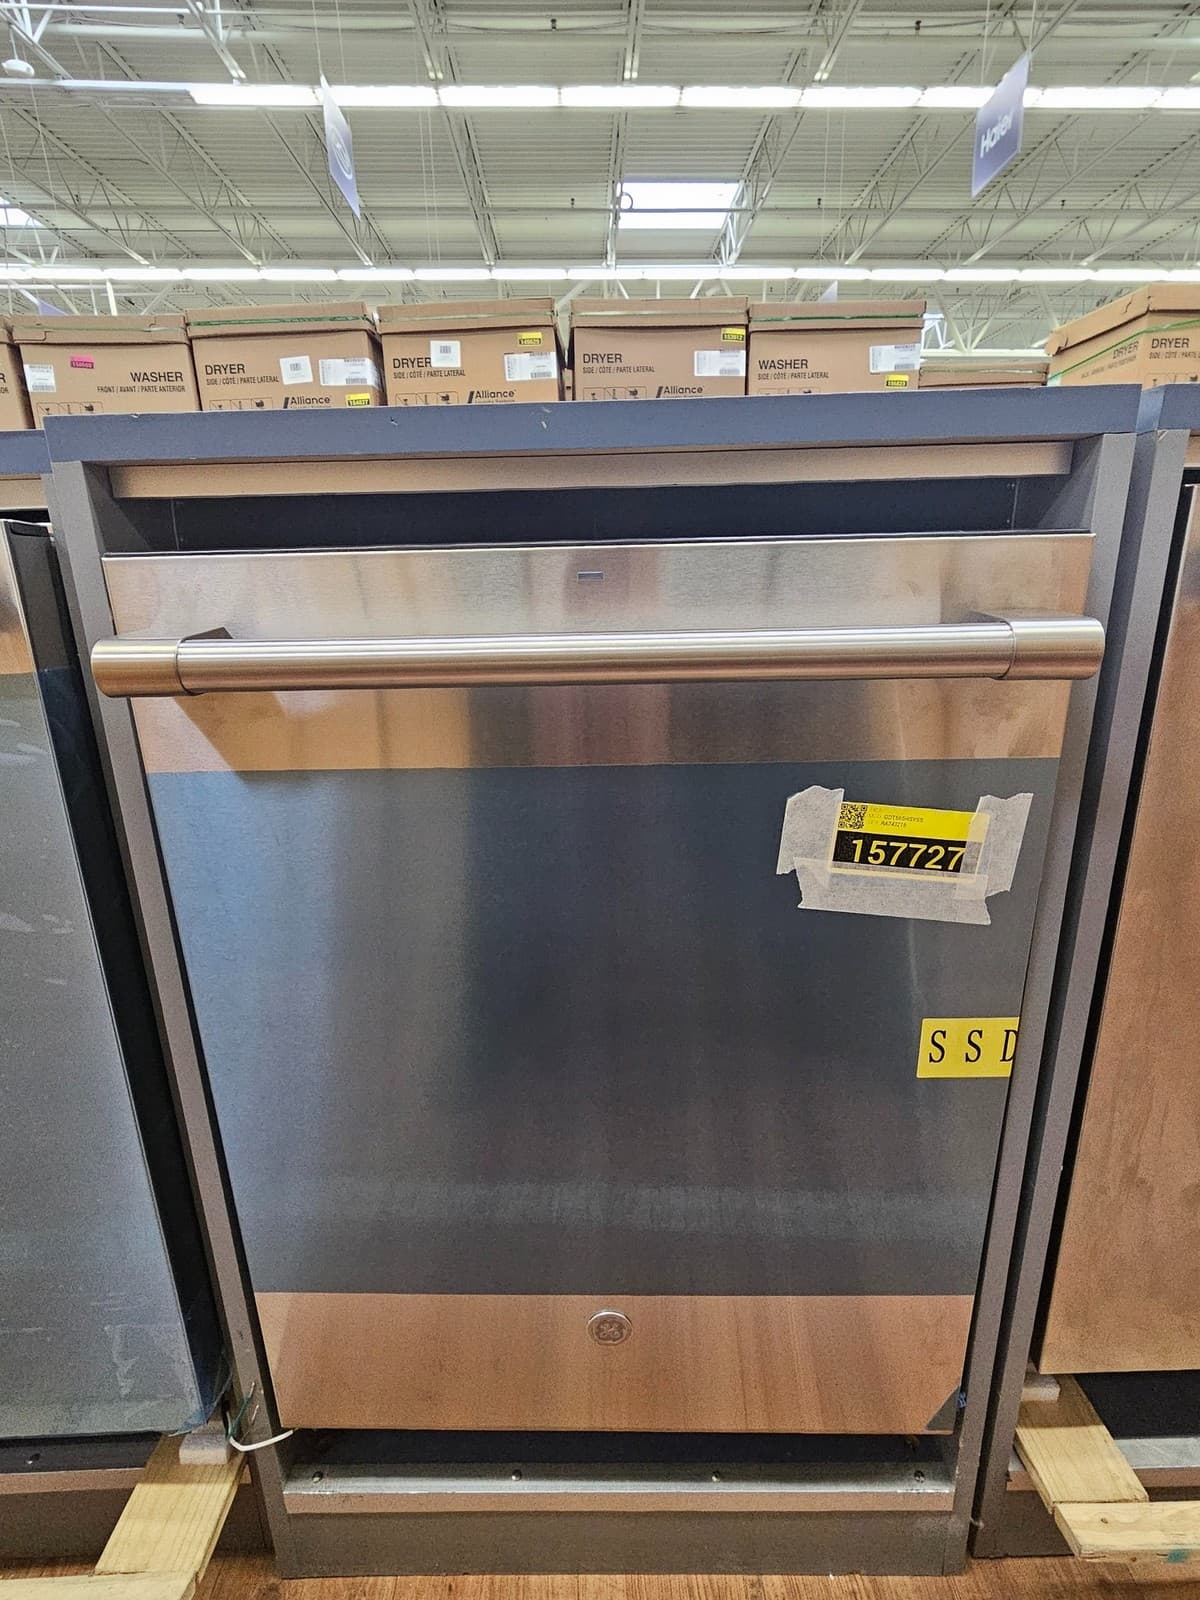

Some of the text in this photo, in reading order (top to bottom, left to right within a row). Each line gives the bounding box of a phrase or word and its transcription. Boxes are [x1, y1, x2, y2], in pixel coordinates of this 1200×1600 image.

[1151, 338, 1190, 349] DRYER
[1112, 341, 1139, 359] DRYER
[392, 357, 432, 369] DRYER
[582, 353, 623, 364] DRYER
[205, 363, 246, 375] DRYER
[758, 359, 809, 370] WASHER
[130, 371, 184, 383] WASHER
[475, 390, 515, 399] Alliance
[664, 386, 704, 395] Alliance
[291, 395, 331, 405] Alliance
[850, 839, 965, 871] 157727
